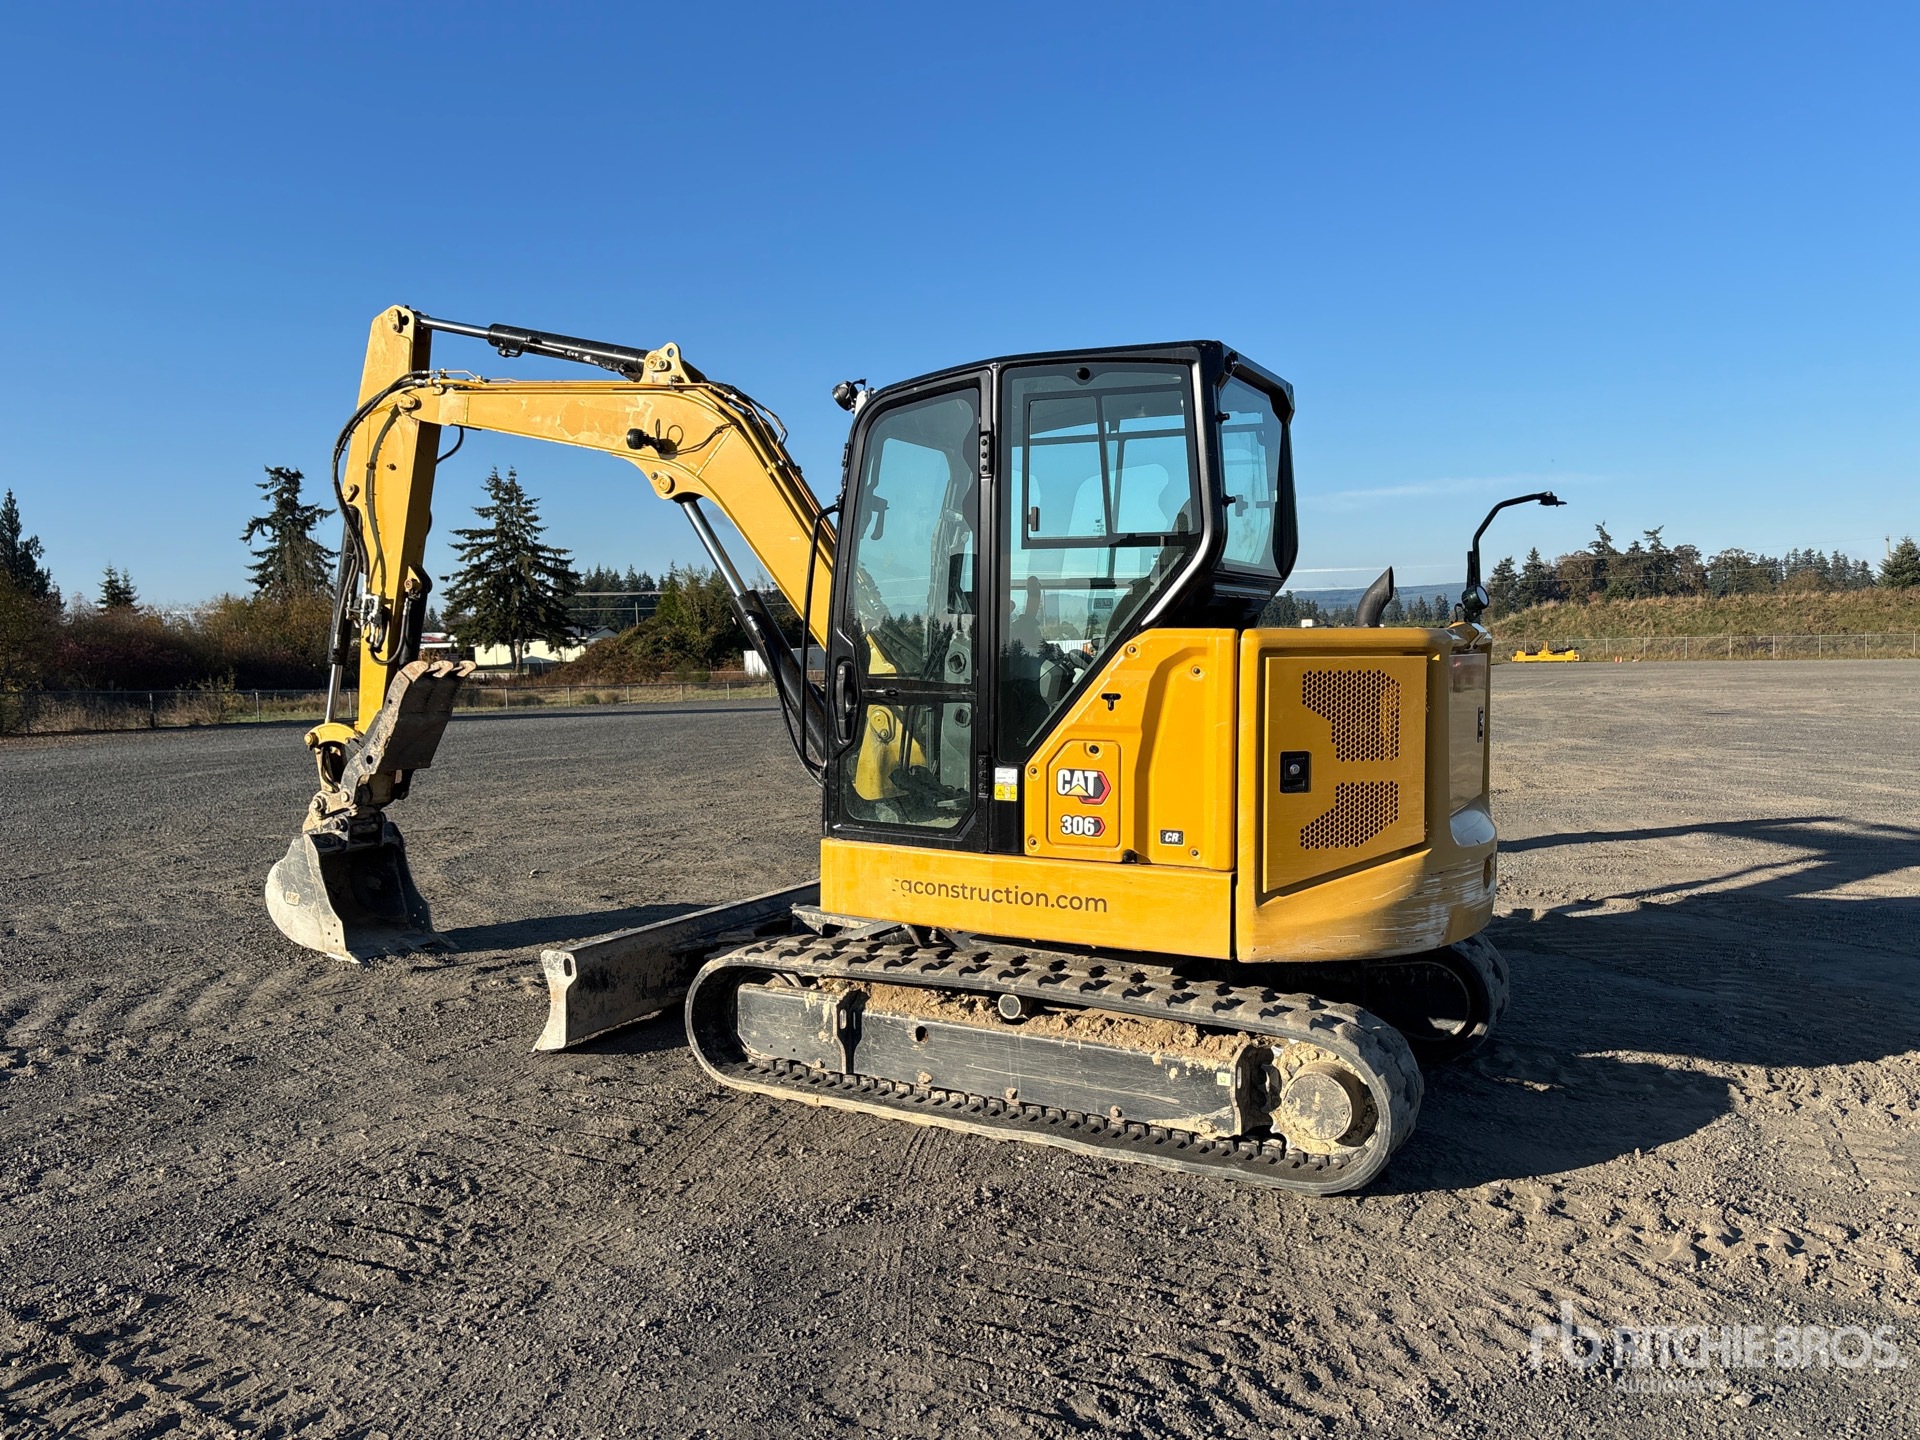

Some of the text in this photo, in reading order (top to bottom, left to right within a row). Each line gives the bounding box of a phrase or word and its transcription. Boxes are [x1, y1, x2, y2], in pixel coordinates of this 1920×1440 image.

[1057, 769, 1098, 796] CAT
[1061, 815, 1095, 835] 306
[1164, 832, 1179, 842] CR
